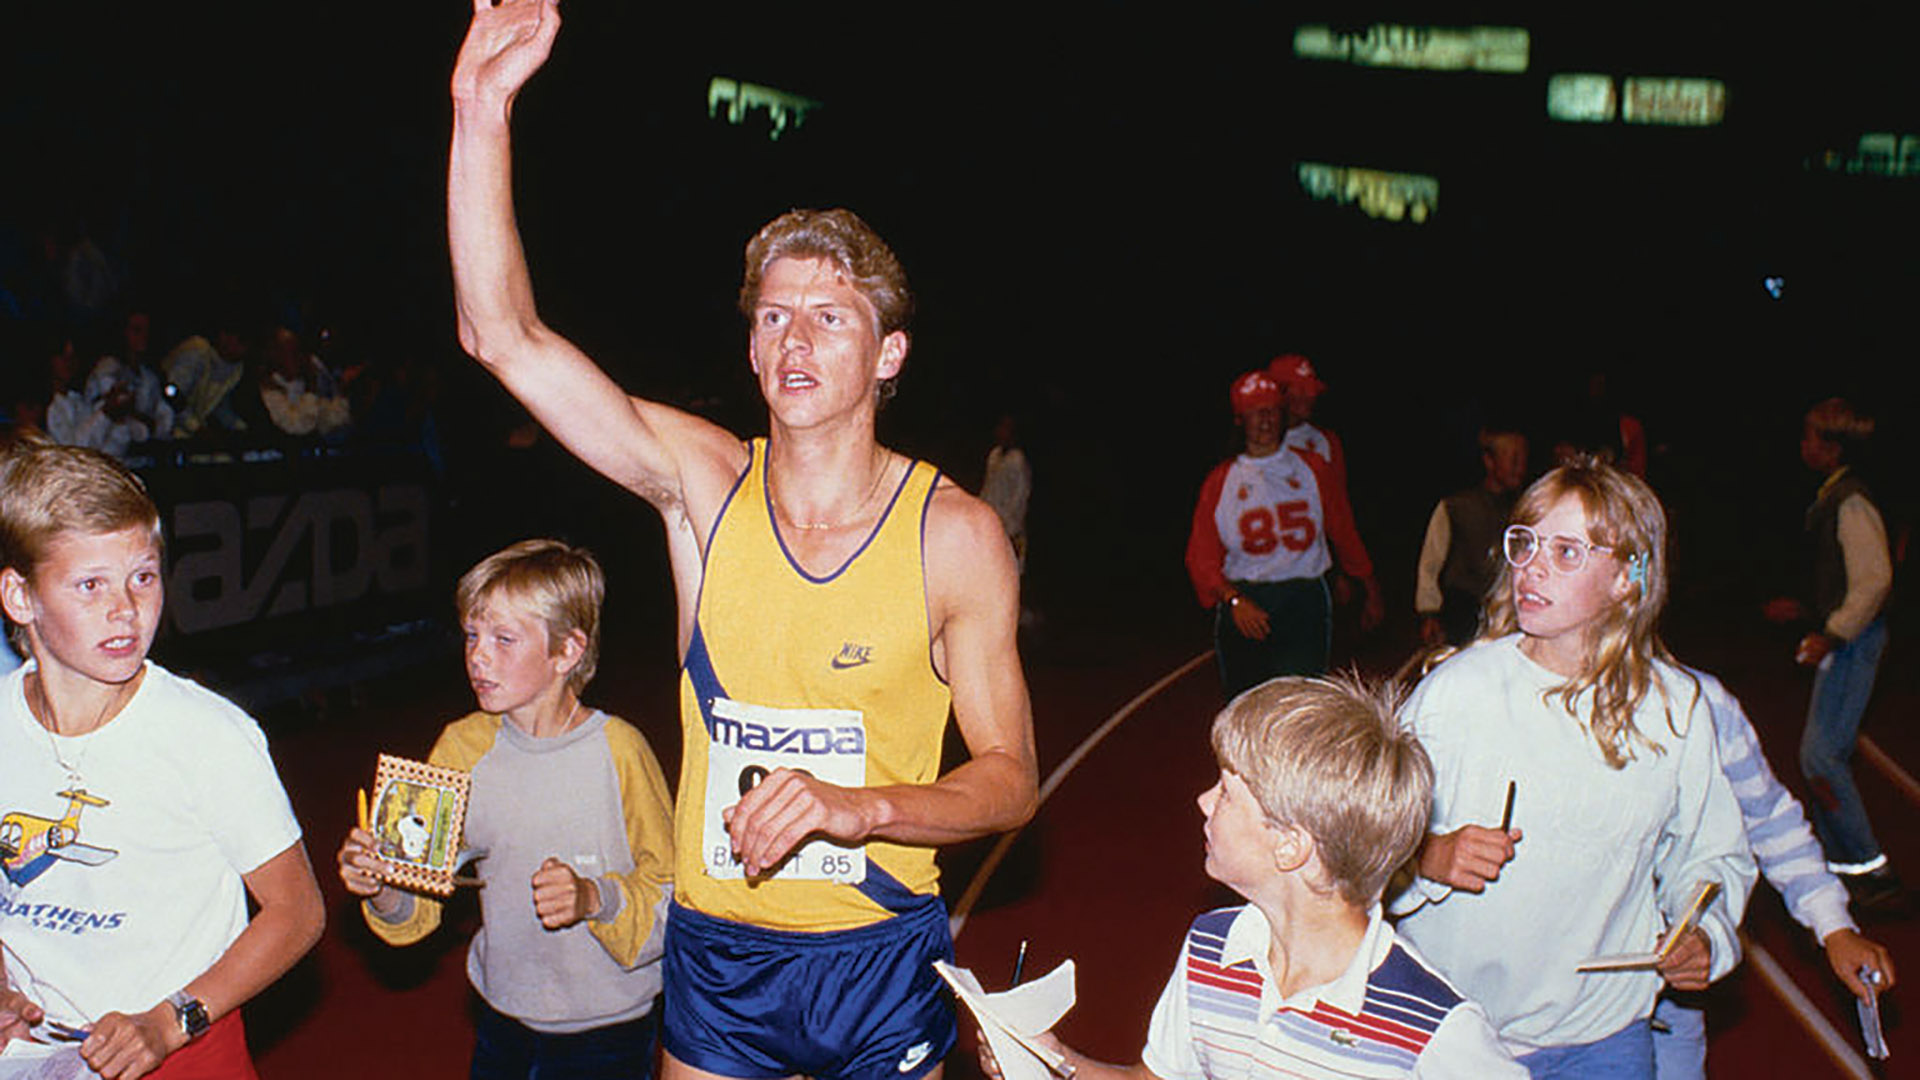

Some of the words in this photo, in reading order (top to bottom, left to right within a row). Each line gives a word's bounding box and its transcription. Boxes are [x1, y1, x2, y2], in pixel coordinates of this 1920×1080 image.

[1238, 499, 1317, 555] 85
[839, 642, 874, 660] NIKE
[821, 855, 852, 875] 85
